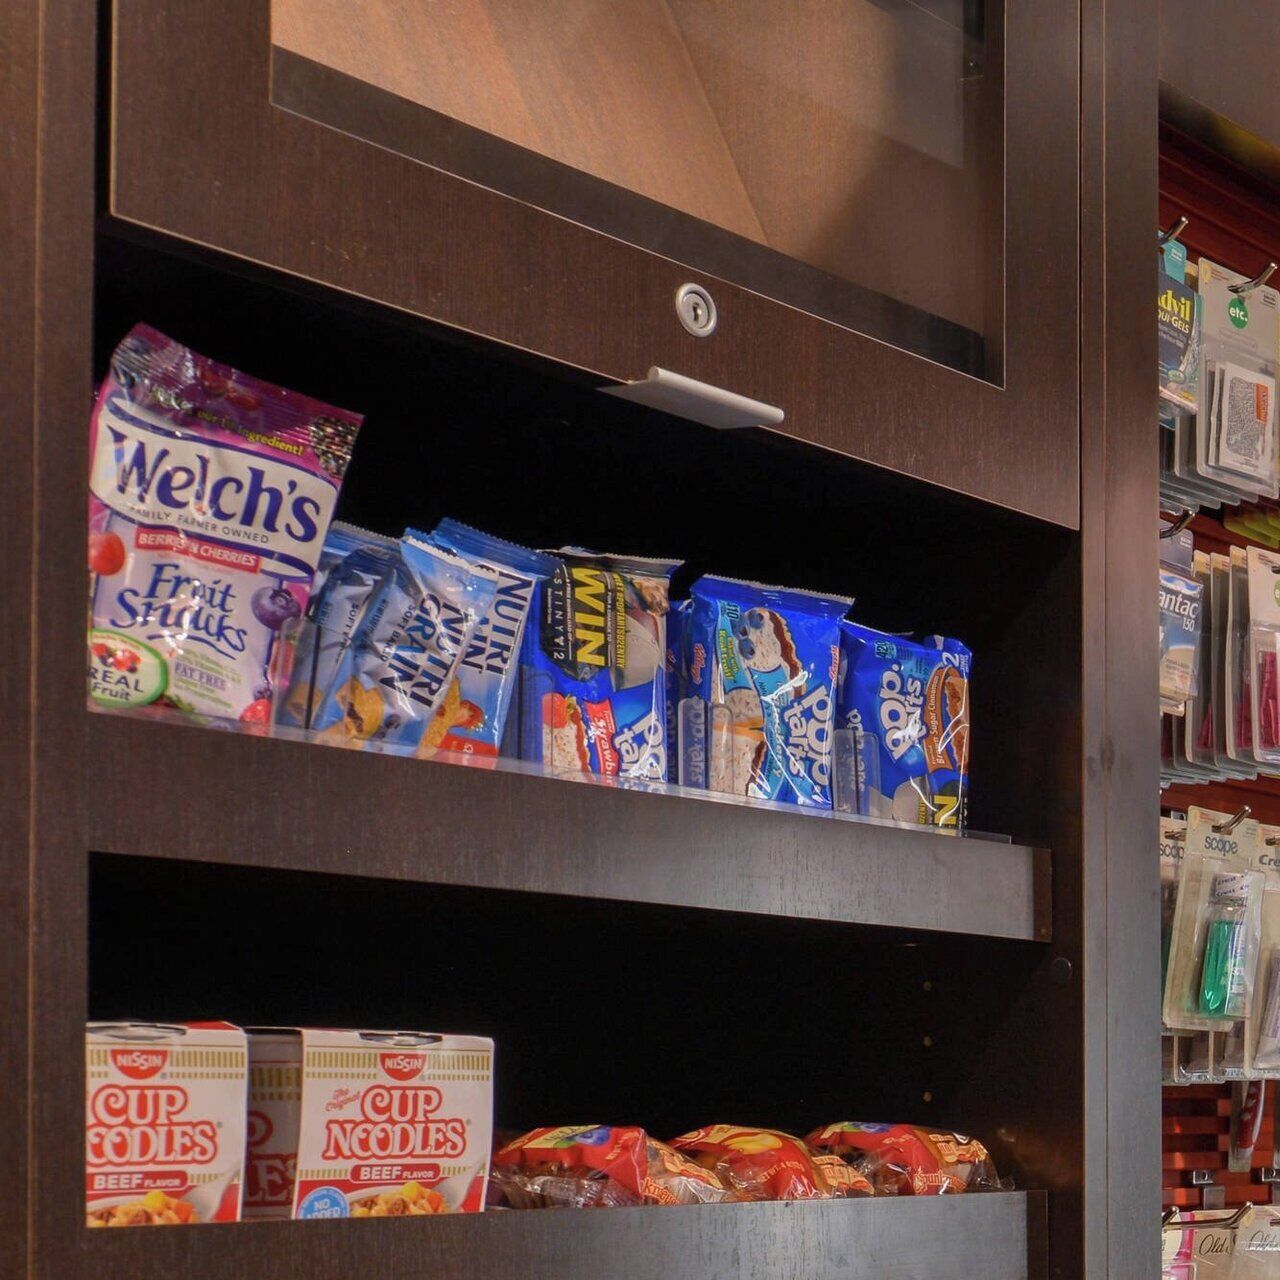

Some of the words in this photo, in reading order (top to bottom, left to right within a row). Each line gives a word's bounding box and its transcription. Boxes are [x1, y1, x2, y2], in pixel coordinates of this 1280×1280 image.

[1229, 307, 1248, 322] etc.
[106, 424, 320, 543] Welch's
[222, 526, 269, 544] OWNED
[200, 545, 257, 566] CHERRIES
[143, 563, 237, 613] Fruit
[110, 588, 247, 652] Snacks
[486, 570, 533, 676] NUTRI
[571, 567, 607, 667] WIN
[1182, 617, 1195, 632] 150
[88, 668, 144, 693] REAL
[929, 675, 939, 707] Cinnamon
[92, 682, 132, 701] Fruit
[1205, 836, 1238, 856] scope
[117, 1052, 163, 1070] NISSIN
[385, 1055, 423, 1072] NISSIN
[94, 1085, 184, 1126] CUP
[363, 1087, 439, 1121] CUP
[324, 1120, 464, 1158] NOODLES
[93, 1174, 143, 1189] BEEF
[144, 1179, 180, 1187] FLAVOR
[359, 1166, 402, 1179] BEEF
[402, 1170, 434, 1179] FLAVOR
[314, 1200, 329, 1210] NO
